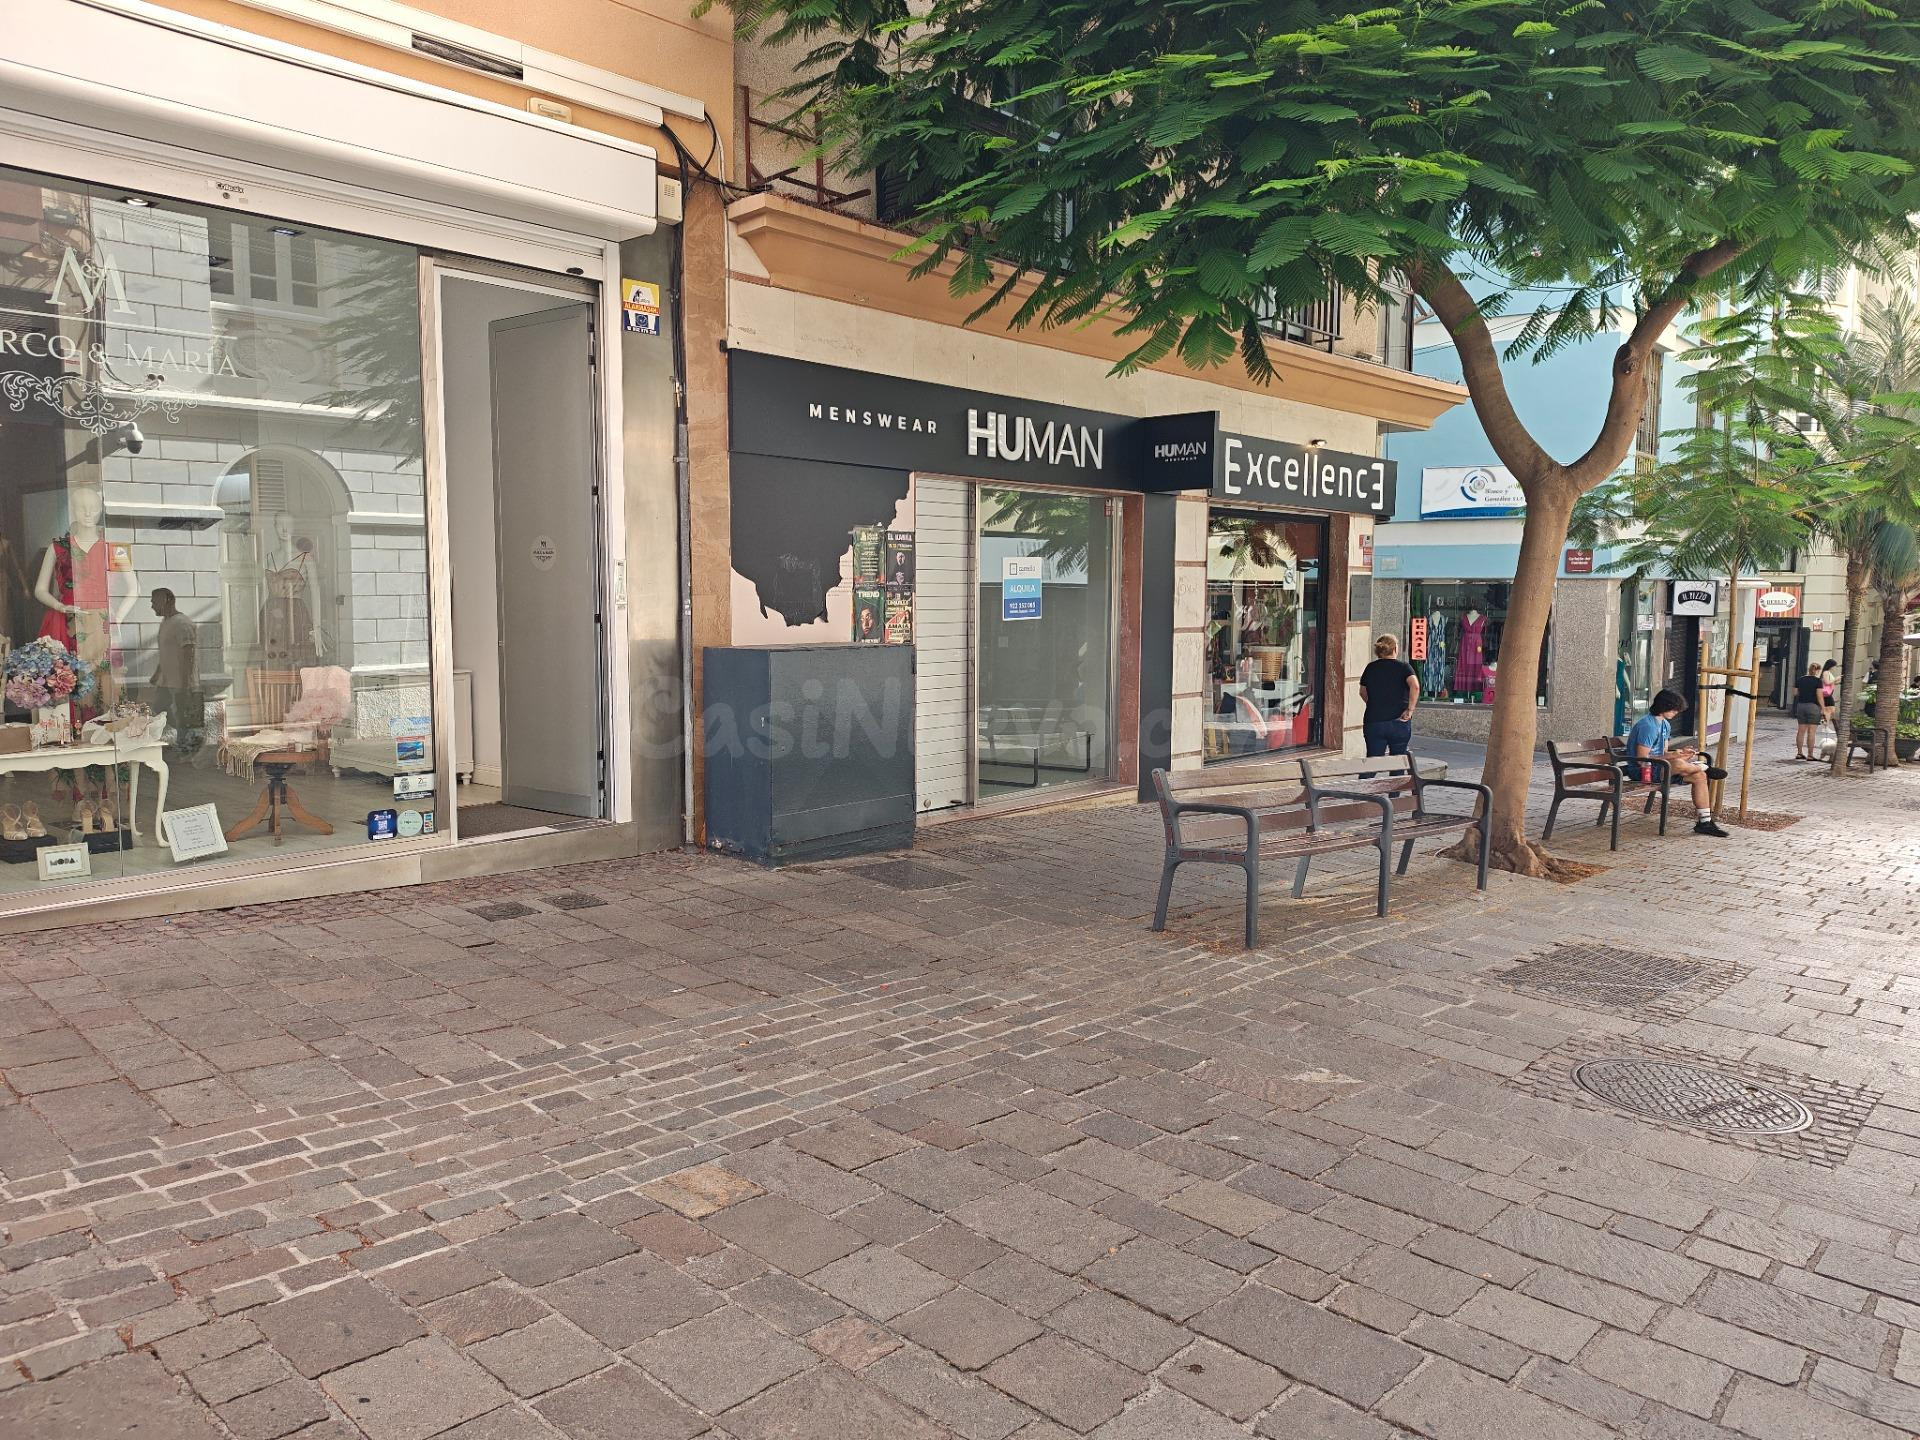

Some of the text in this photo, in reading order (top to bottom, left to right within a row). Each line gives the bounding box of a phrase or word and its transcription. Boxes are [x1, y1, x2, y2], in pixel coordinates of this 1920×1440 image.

[88, 343, 110, 365] &
[124, 343, 239, 378] MARÍA
[809, 403, 938, 434] MENSWEAR
[967, 408, 1103, 470] HUMAN
[1154, 441, 1207, 458] HUMAN
[1009, 584, 1036, 593] ALQUILA
[1414, 619, 1425, 659] REBAJAS
